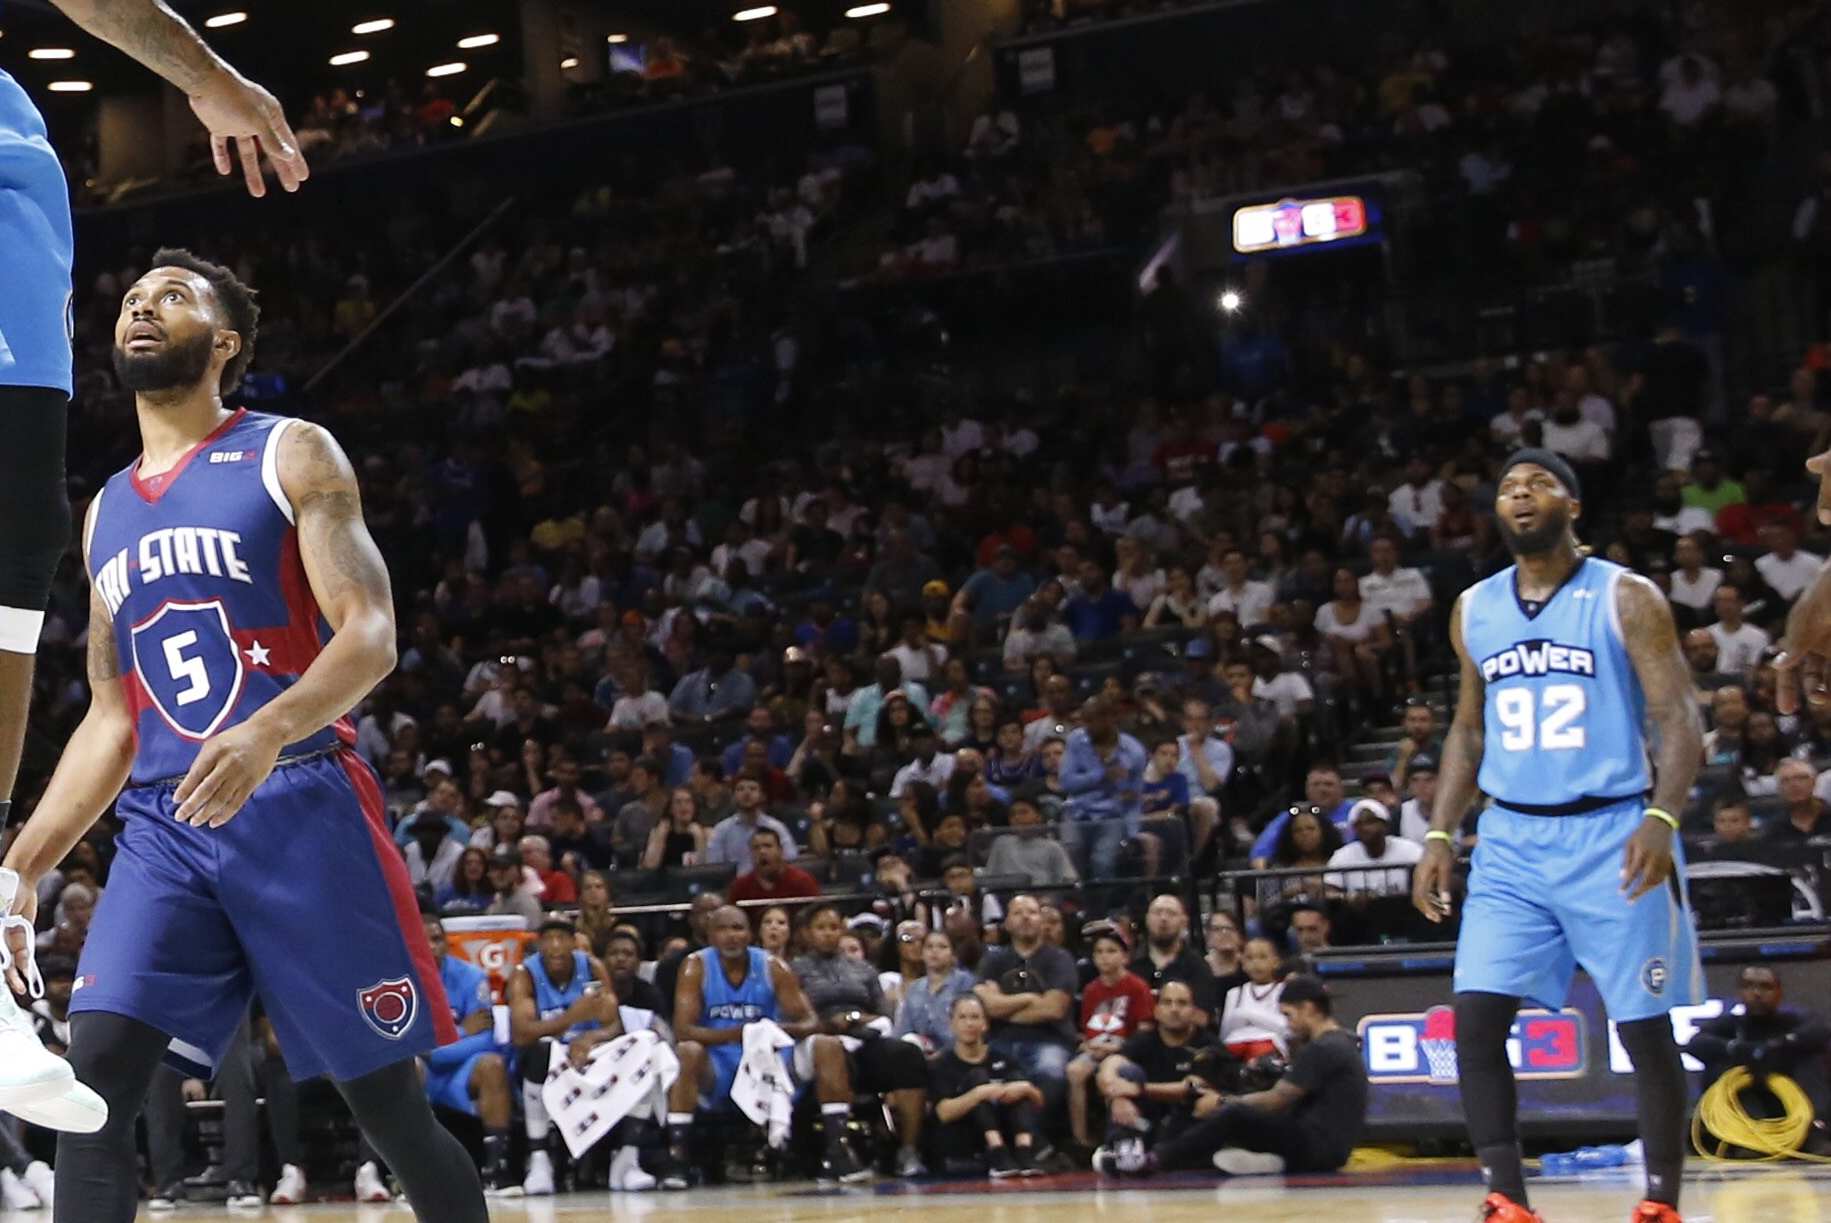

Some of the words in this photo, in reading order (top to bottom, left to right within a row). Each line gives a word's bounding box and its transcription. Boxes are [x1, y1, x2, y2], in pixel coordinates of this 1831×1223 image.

[138, 527, 254, 585] STATE
[161, 629, 211, 707] 5
[1481, 637, 1597, 684] POWER
[1495, 683, 1587, 753] 92
[479, 942, 505, 969] G
